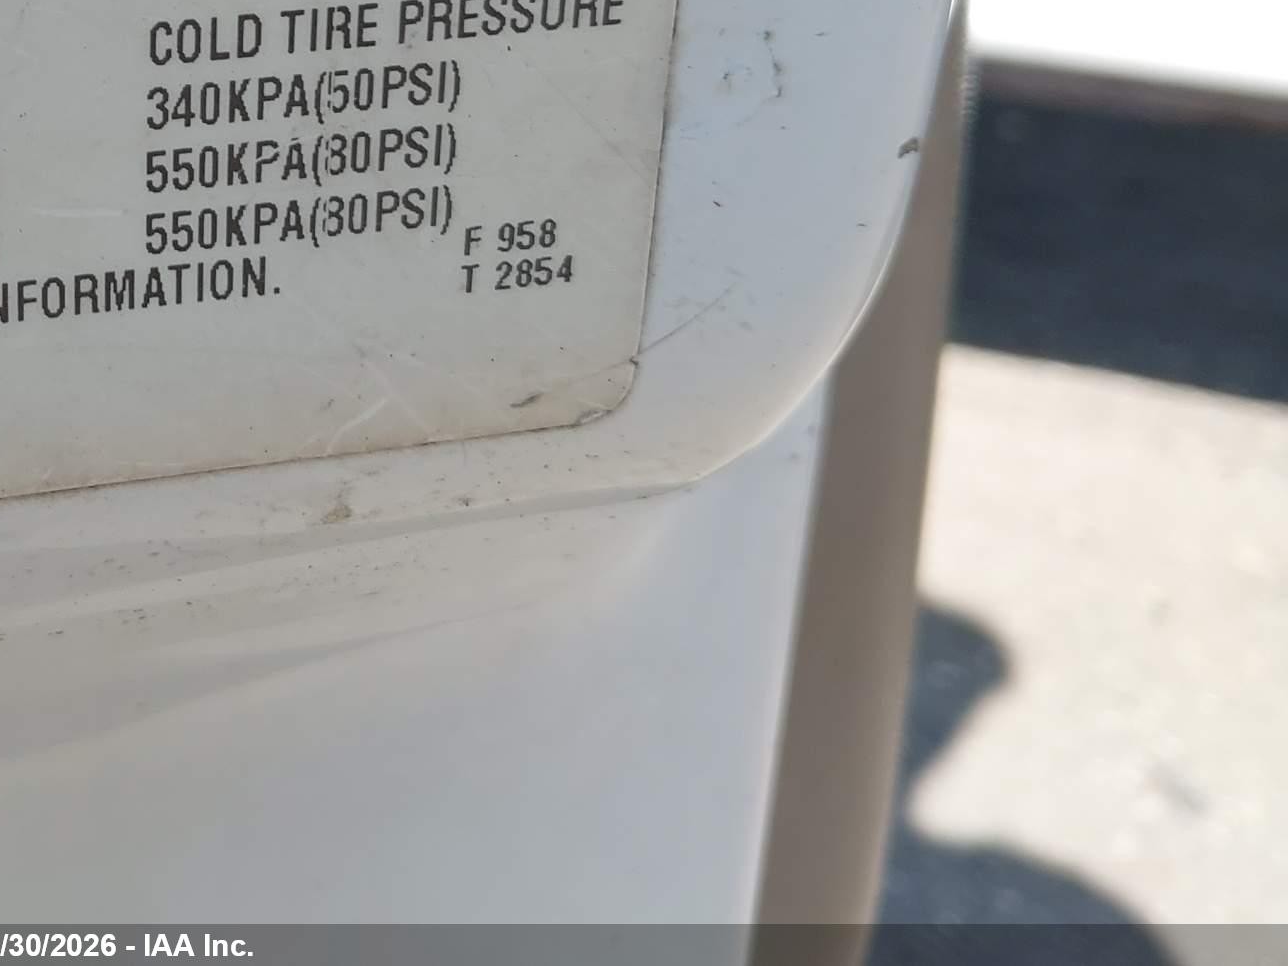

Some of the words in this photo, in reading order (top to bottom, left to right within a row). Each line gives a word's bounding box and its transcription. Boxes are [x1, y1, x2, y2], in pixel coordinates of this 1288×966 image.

[150, 14, 262, 65] COLD
[280, 3, 378, 54] TIRE
[147, 60, 460, 130] 340KPA(50PSI)
[464, 226, 482, 256] F
[498, 219, 556, 252] 958
[461, 264, 479, 293] T
[495, 255, 573, 290] 2854
